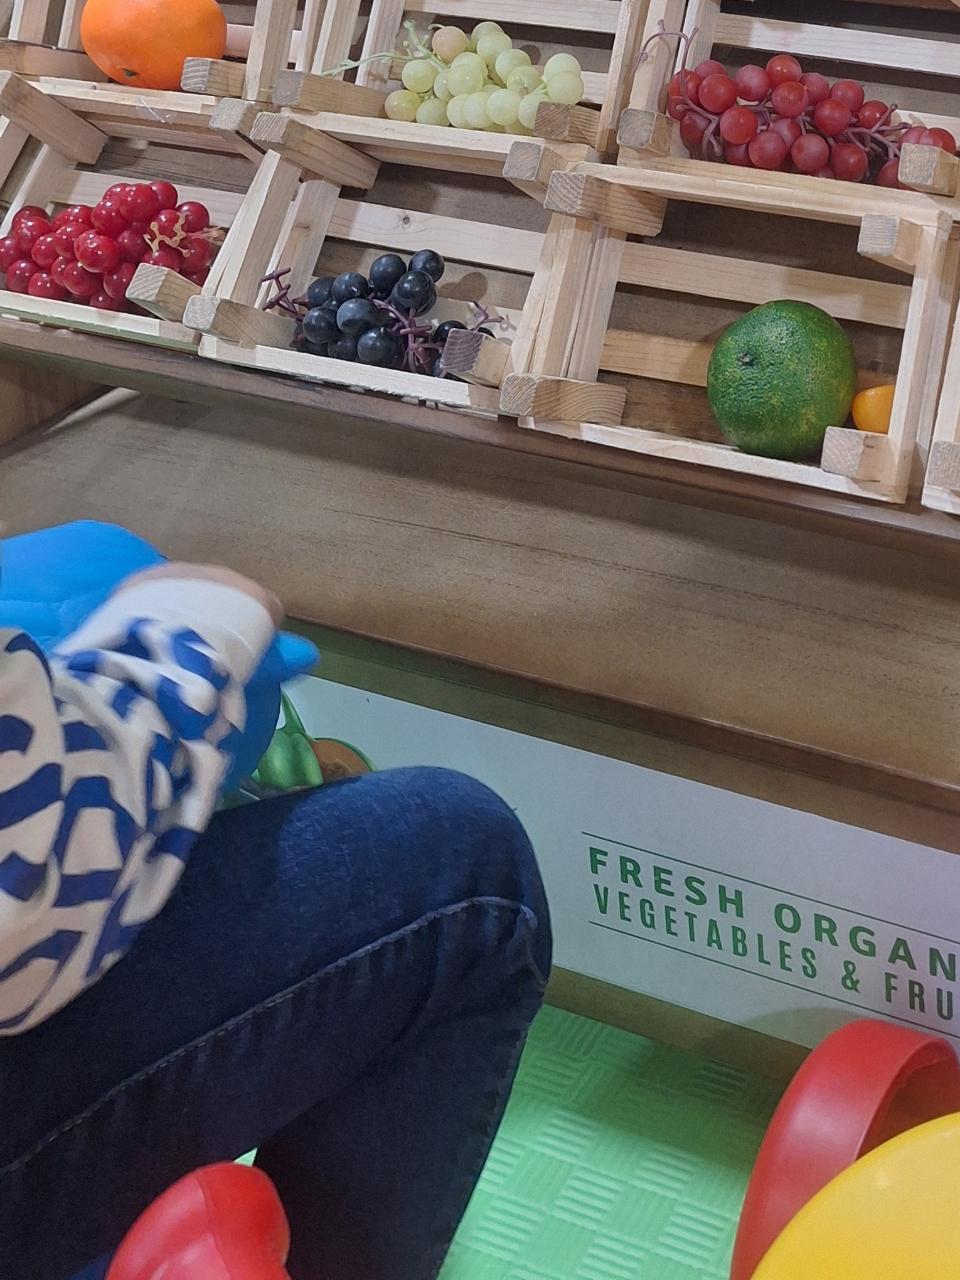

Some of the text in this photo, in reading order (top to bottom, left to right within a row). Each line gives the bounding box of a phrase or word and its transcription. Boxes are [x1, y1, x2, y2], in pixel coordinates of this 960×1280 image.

[589, 846, 744, 918] FRESH
[594, 883, 818, 980] VEGETABLES
[841, 959, 861, 993] &
